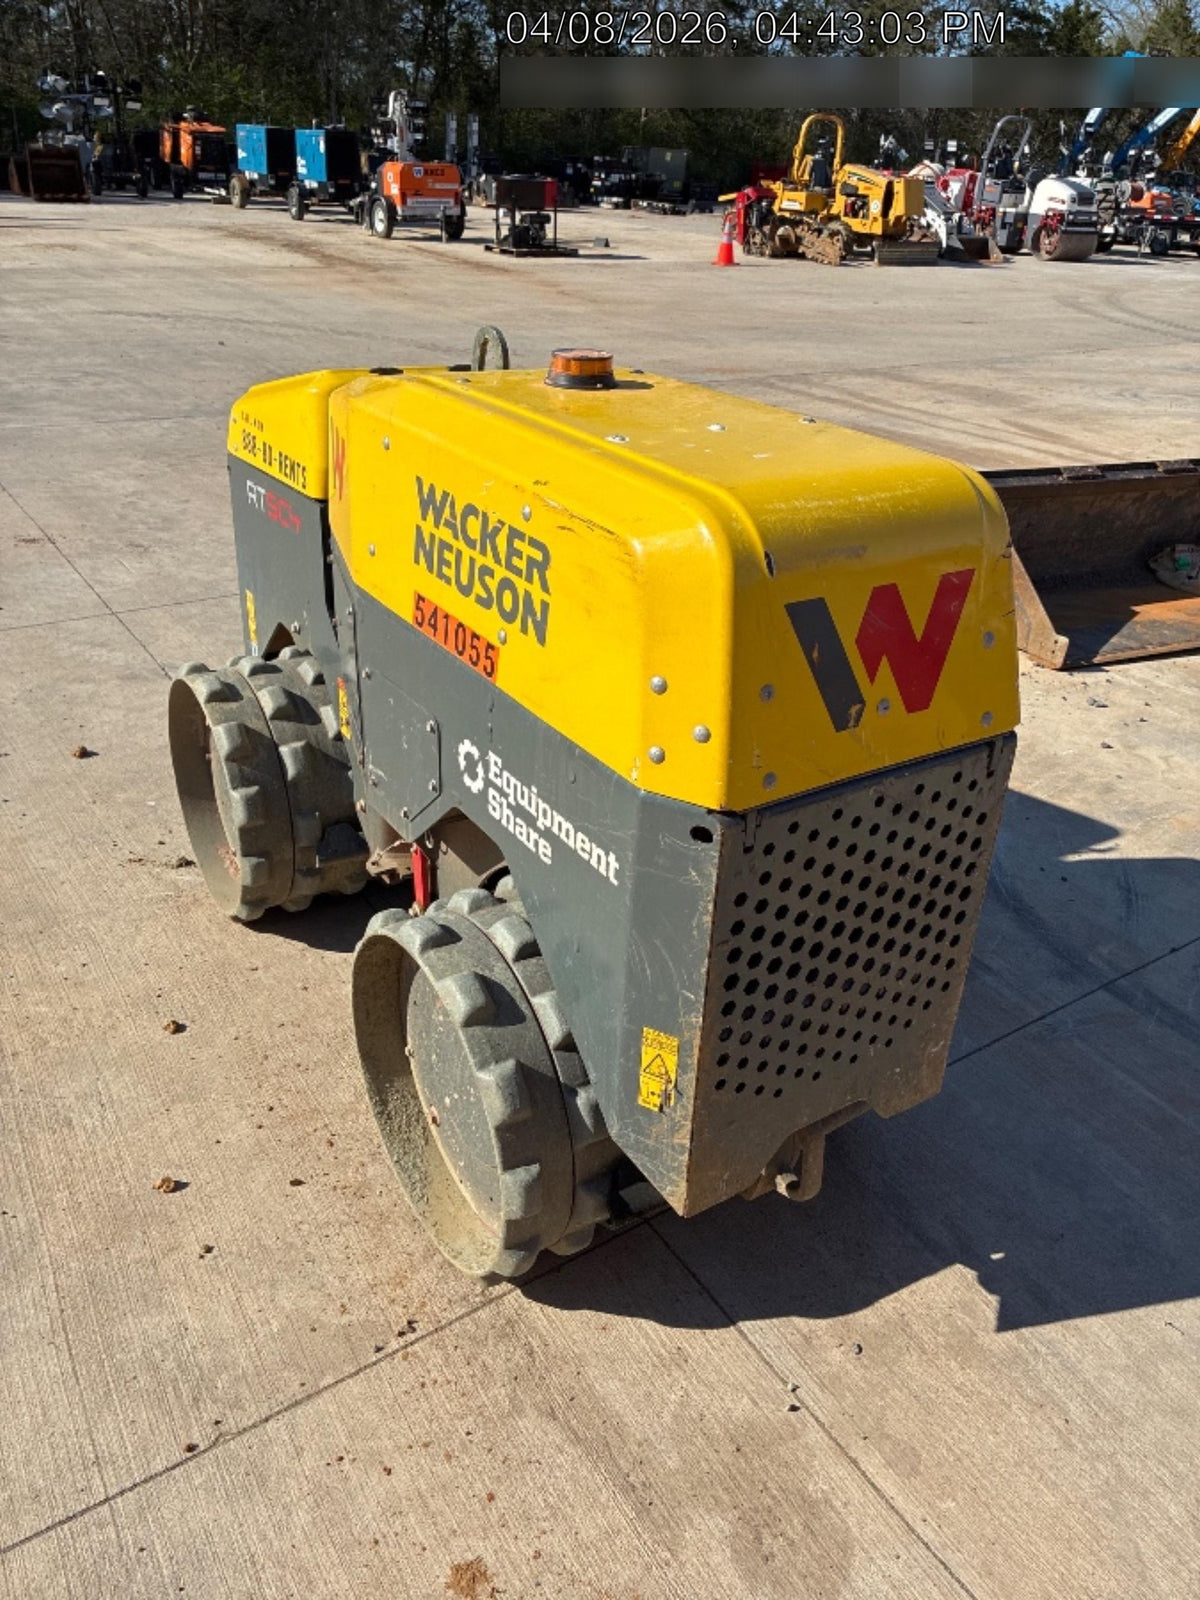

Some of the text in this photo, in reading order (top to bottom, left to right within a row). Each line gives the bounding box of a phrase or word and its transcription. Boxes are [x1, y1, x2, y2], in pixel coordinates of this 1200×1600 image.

[413, 523, 550, 648] NEUSON
[415, 474, 551, 596] WACKER
[414, 593, 496, 679] 541055
[486, 750, 620, 887] Equipment
[487, 787, 552, 865] Share
